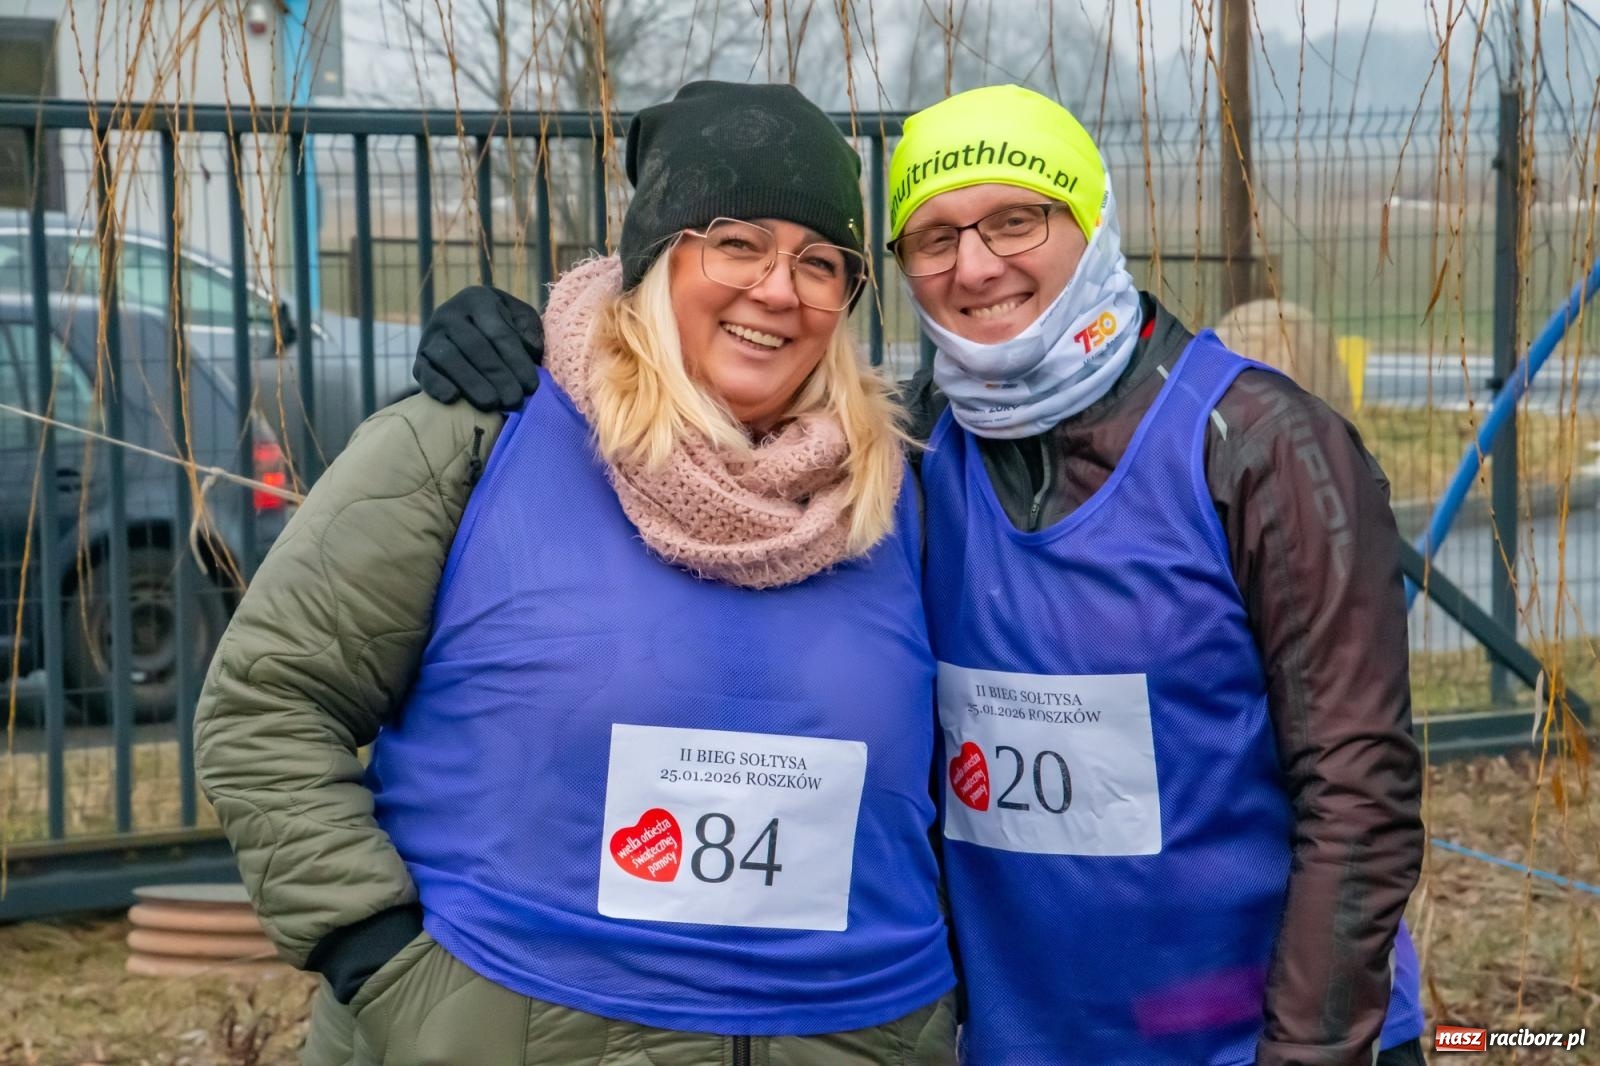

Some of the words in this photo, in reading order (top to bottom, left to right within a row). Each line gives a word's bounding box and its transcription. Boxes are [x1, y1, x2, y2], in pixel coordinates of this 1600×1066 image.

[1073, 311, 1118, 355] 750
[975, 684, 986, 697] II
[988, 686, 1018, 702] BIEG
[1020, 690, 1083, 706] SOŁTYSA
[1028, 708, 1102, 724] ROSZKÓW
[679, 748, 693, 762] II
[696, 749, 736, 765] BIEG
[739, 752, 808, 770] SOŁTYSA
[660, 768, 742, 785] 25.01.2026
[746, 771, 823, 791] ROSZKÓW
[995, 745, 1073, 814] 20
[640, 819, 672, 843] orkiestra
[690, 812, 783, 887] 84
[647, 851, 677, 878] pomocy
